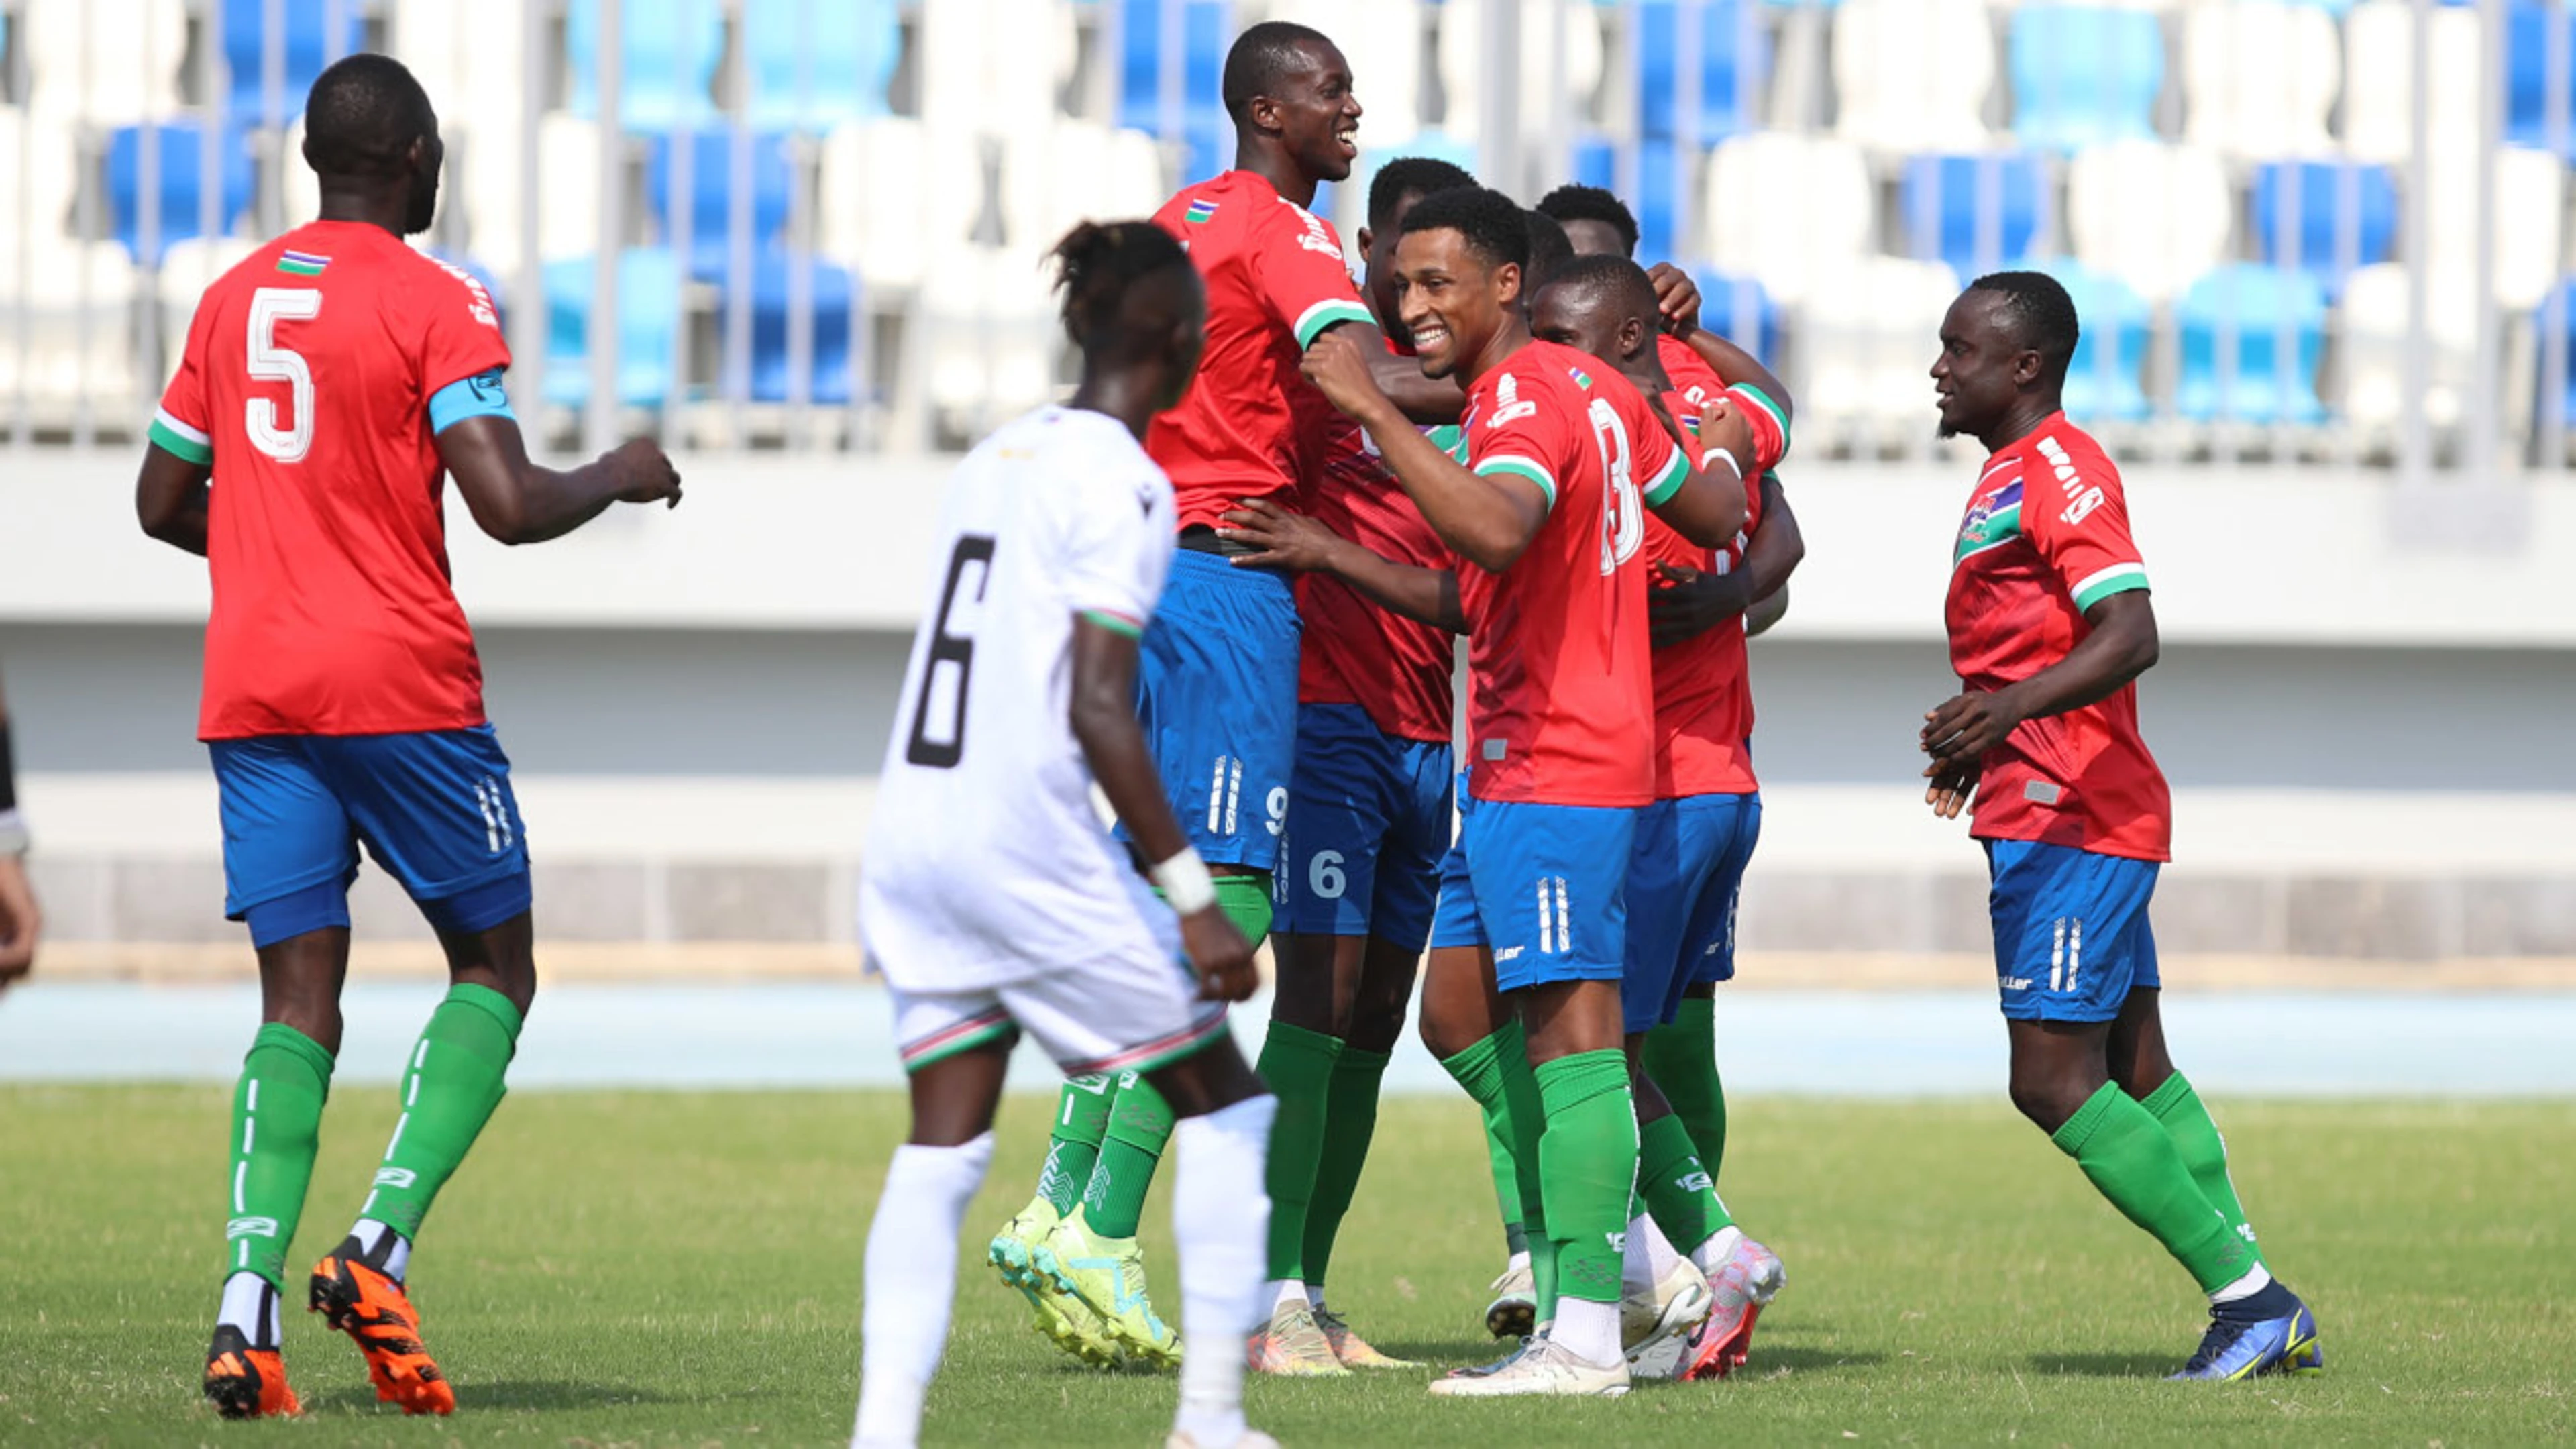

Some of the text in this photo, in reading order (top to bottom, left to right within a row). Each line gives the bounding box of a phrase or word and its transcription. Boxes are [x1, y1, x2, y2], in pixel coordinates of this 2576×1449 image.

[246, 288, 322, 462] 5
[1587, 397, 1644, 576] 13
[908, 533, 996, 768] 6
[1265, 786, 1288, 836] 9
[1309, 850, 1346, 898] 6
